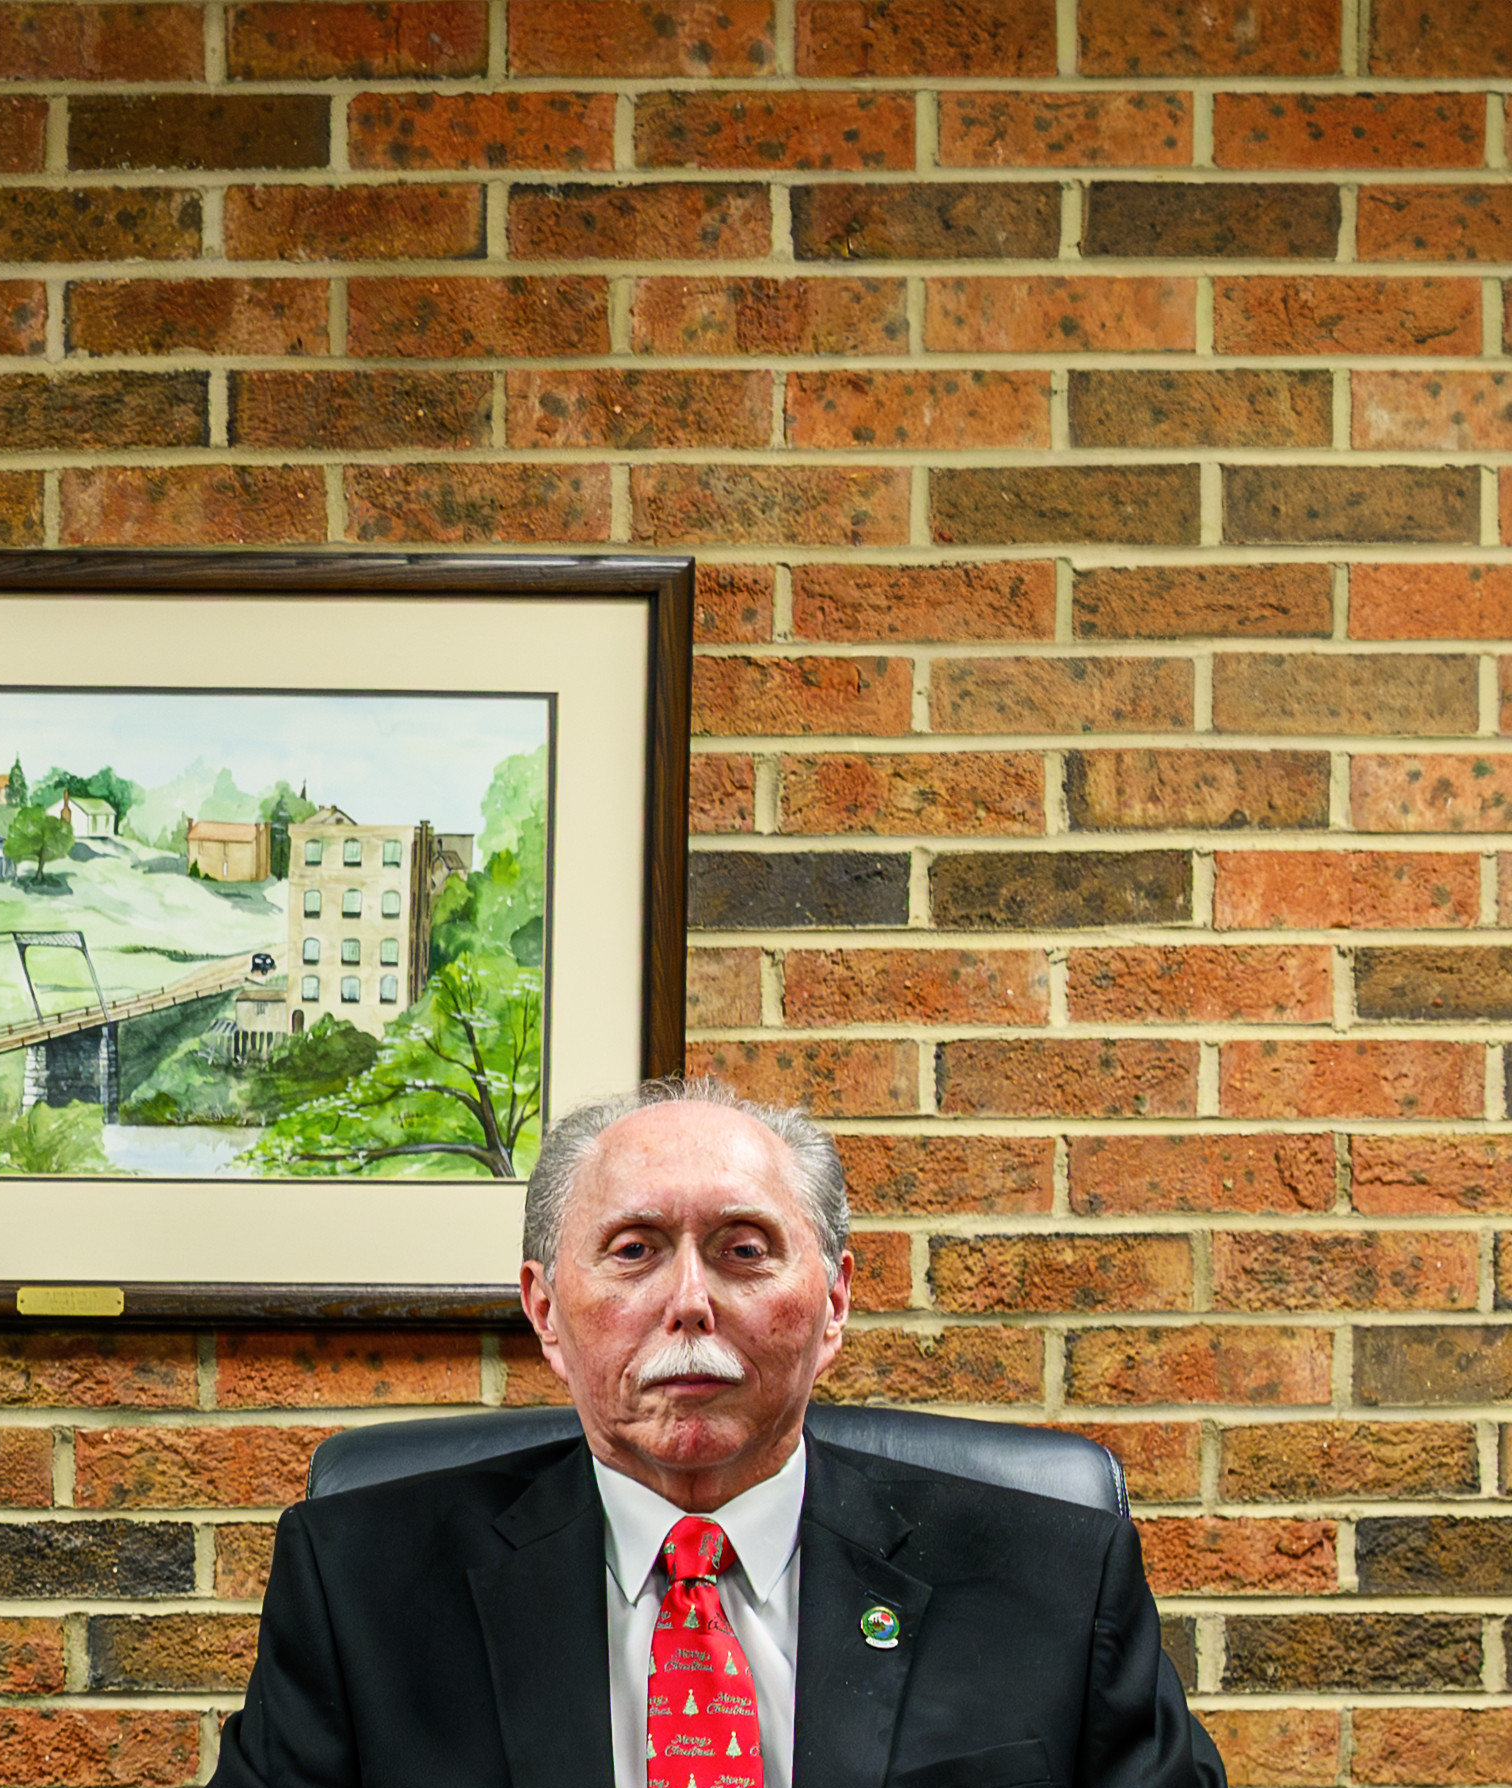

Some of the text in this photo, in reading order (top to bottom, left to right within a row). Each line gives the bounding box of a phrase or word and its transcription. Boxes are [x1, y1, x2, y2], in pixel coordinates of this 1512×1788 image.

[670, 1648, 711, 1661] Merry
[664, 1659, 714, 1672] Christmas
[713, 1691, 752, 1705] Merry
[706, 1703, 755, 1716] Christmas
[671, 1734, 712, 1747] Merry
[664, 1745, 716, 1757] Christmas
[714, 1774, 755, 1787] Merry
